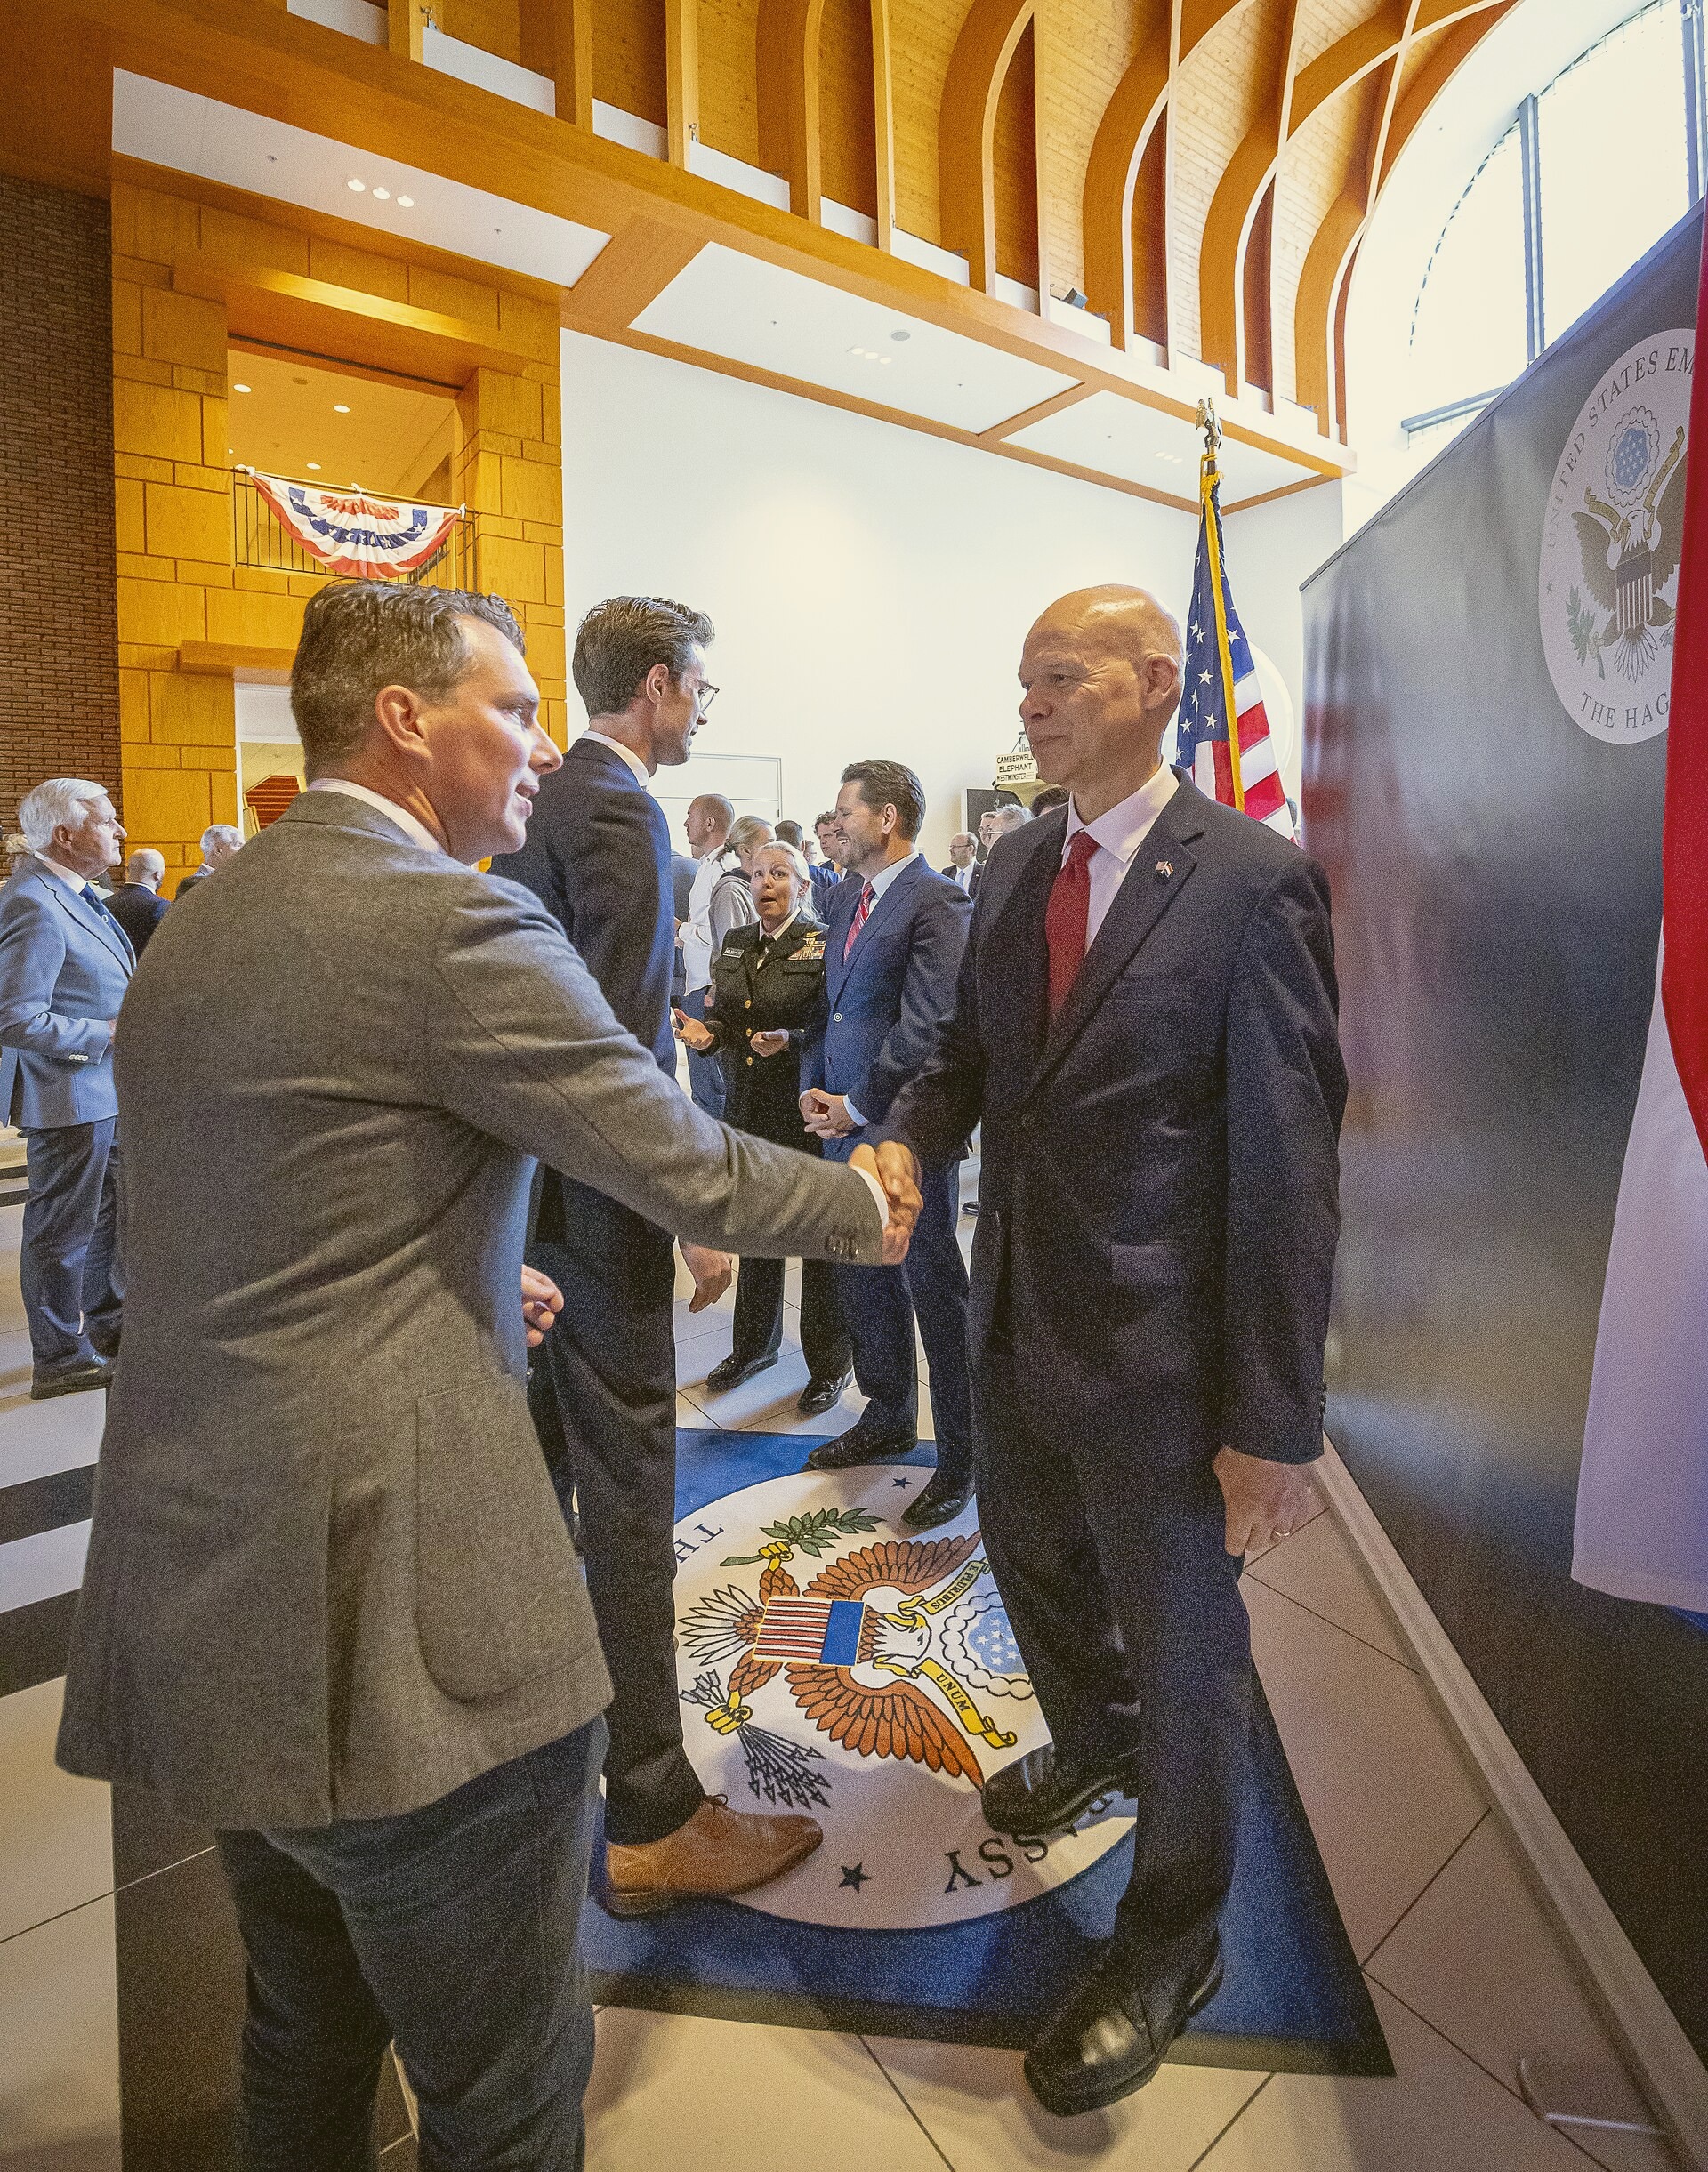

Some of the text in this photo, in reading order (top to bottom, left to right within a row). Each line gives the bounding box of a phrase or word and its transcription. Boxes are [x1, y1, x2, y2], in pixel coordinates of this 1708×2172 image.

[1547, 433, 1585, 549] UNITED
[1588, 350, 1658, 428] STATES
[1581, 692, 1669, 728] THE HAG
[999, 762, 1032, 773] ELEPHANT
[936, 1673, 971, 1712] UNUM
